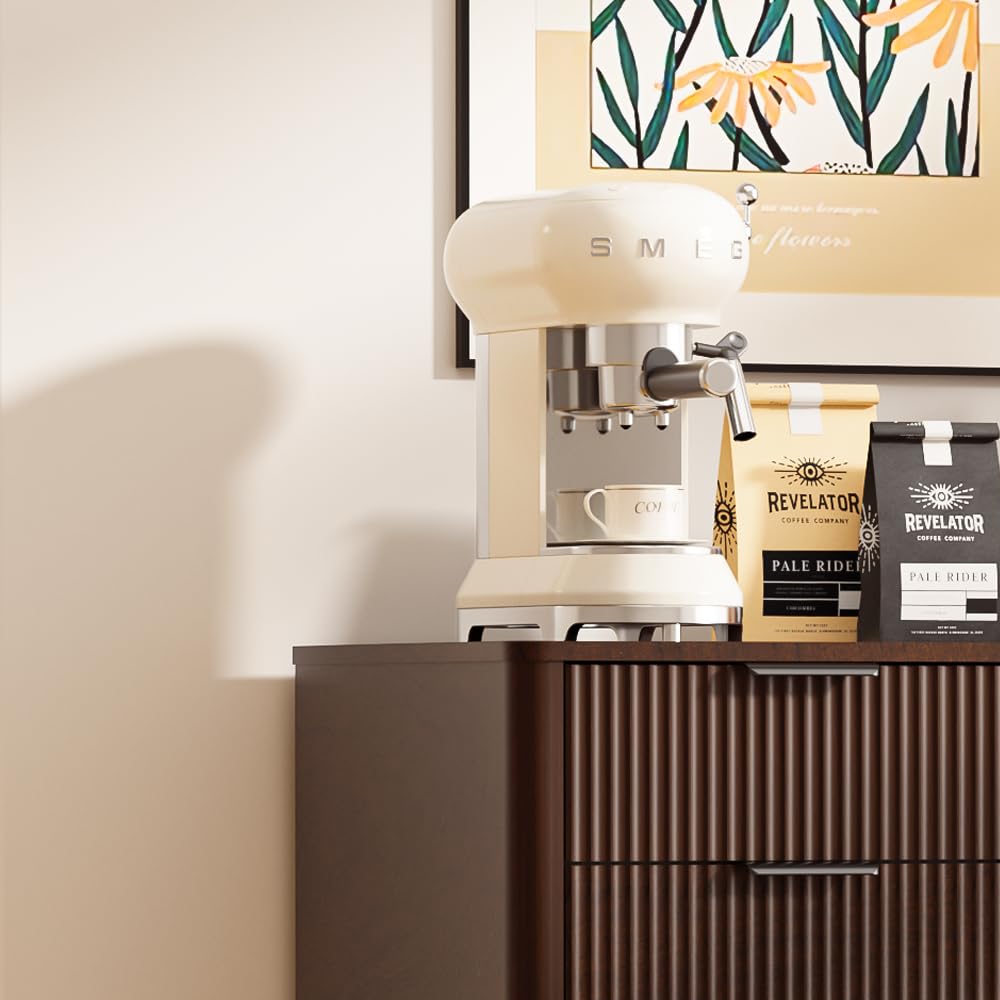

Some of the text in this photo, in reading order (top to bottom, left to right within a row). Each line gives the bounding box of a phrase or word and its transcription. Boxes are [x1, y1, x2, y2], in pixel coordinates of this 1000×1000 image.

[590, 236, 743, 260] SMEG
[767, 491, 860, 515] REVELATOR
[904, 512, 985, 534] REVELATOR
[772, 559, 811, 572] PALE
[909, 572, 989, 582] PALE RIDER
